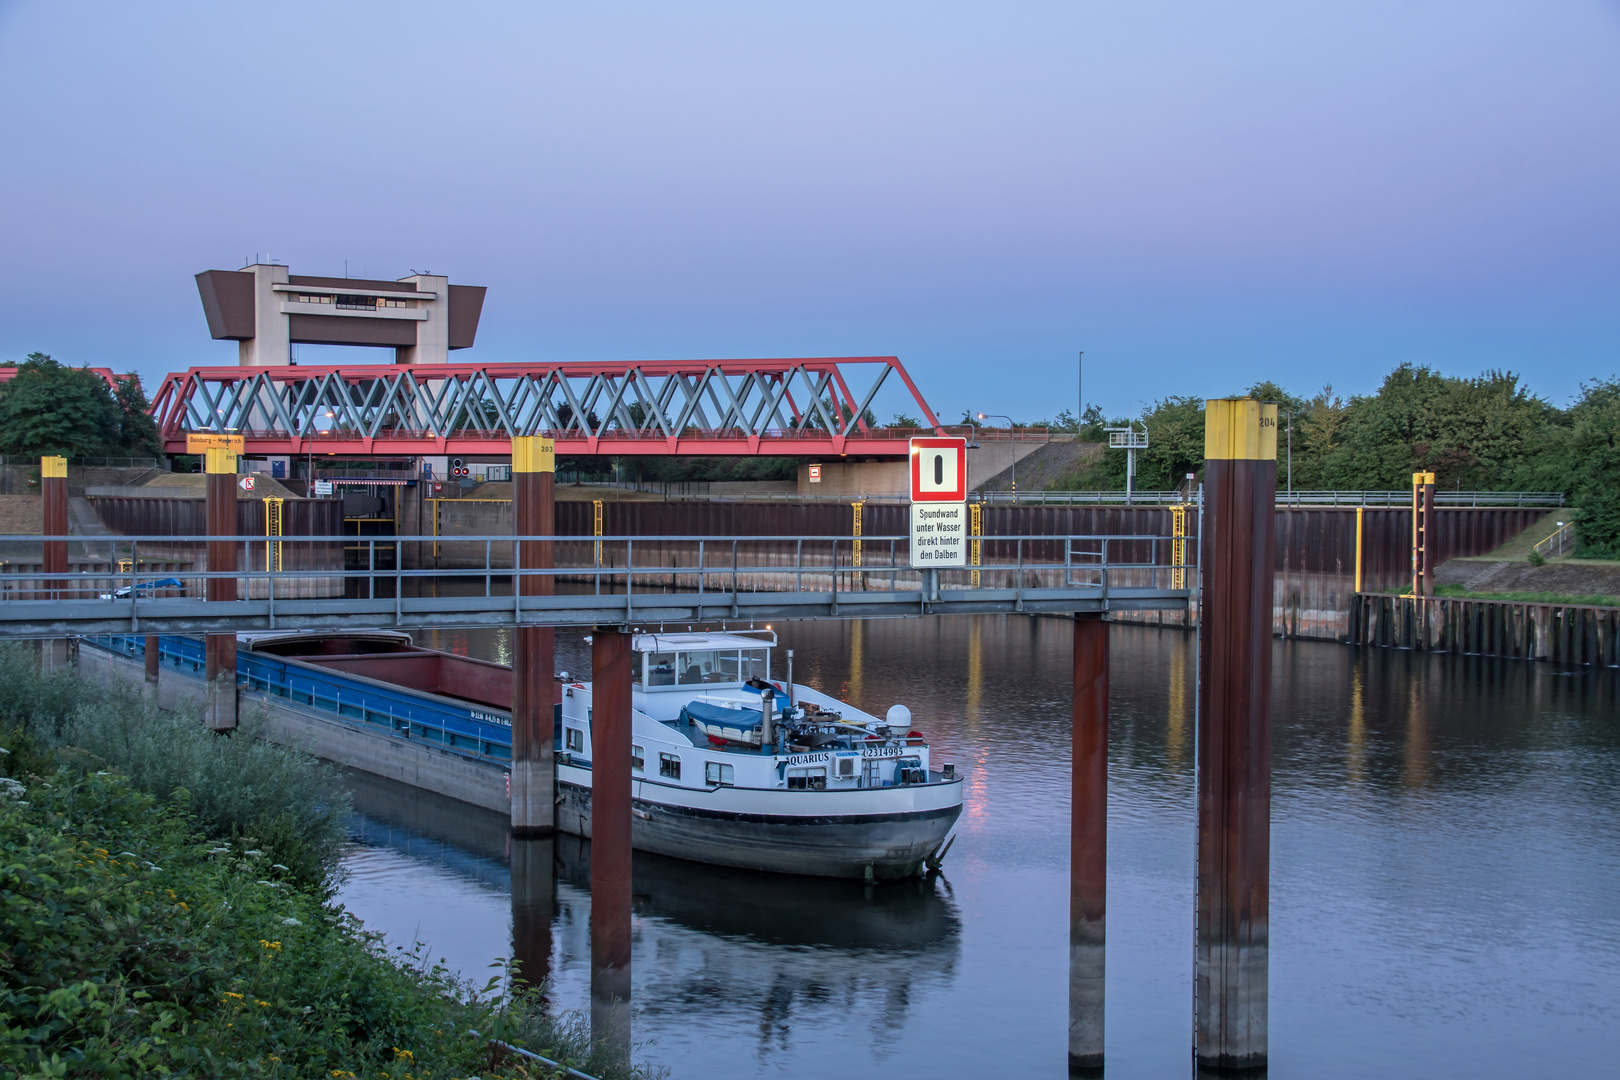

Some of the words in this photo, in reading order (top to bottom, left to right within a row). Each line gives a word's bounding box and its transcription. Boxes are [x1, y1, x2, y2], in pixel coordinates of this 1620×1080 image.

[1259, 417, 1275, 427] 204
[919, 509, 958, 520] Spundwand
[916, 523, 934, 532] unter
[936, 522, 961, 532] Wasser
[917, 536, 938, 546] direkt
[939, 536, 960, 546] hinter
[920, 550, 933, 559] den
[934, 549, 957, 559] Dalben
[863, 747, 903, 757] 02314995
[786, 752, 829, 766] AQUARIUS
